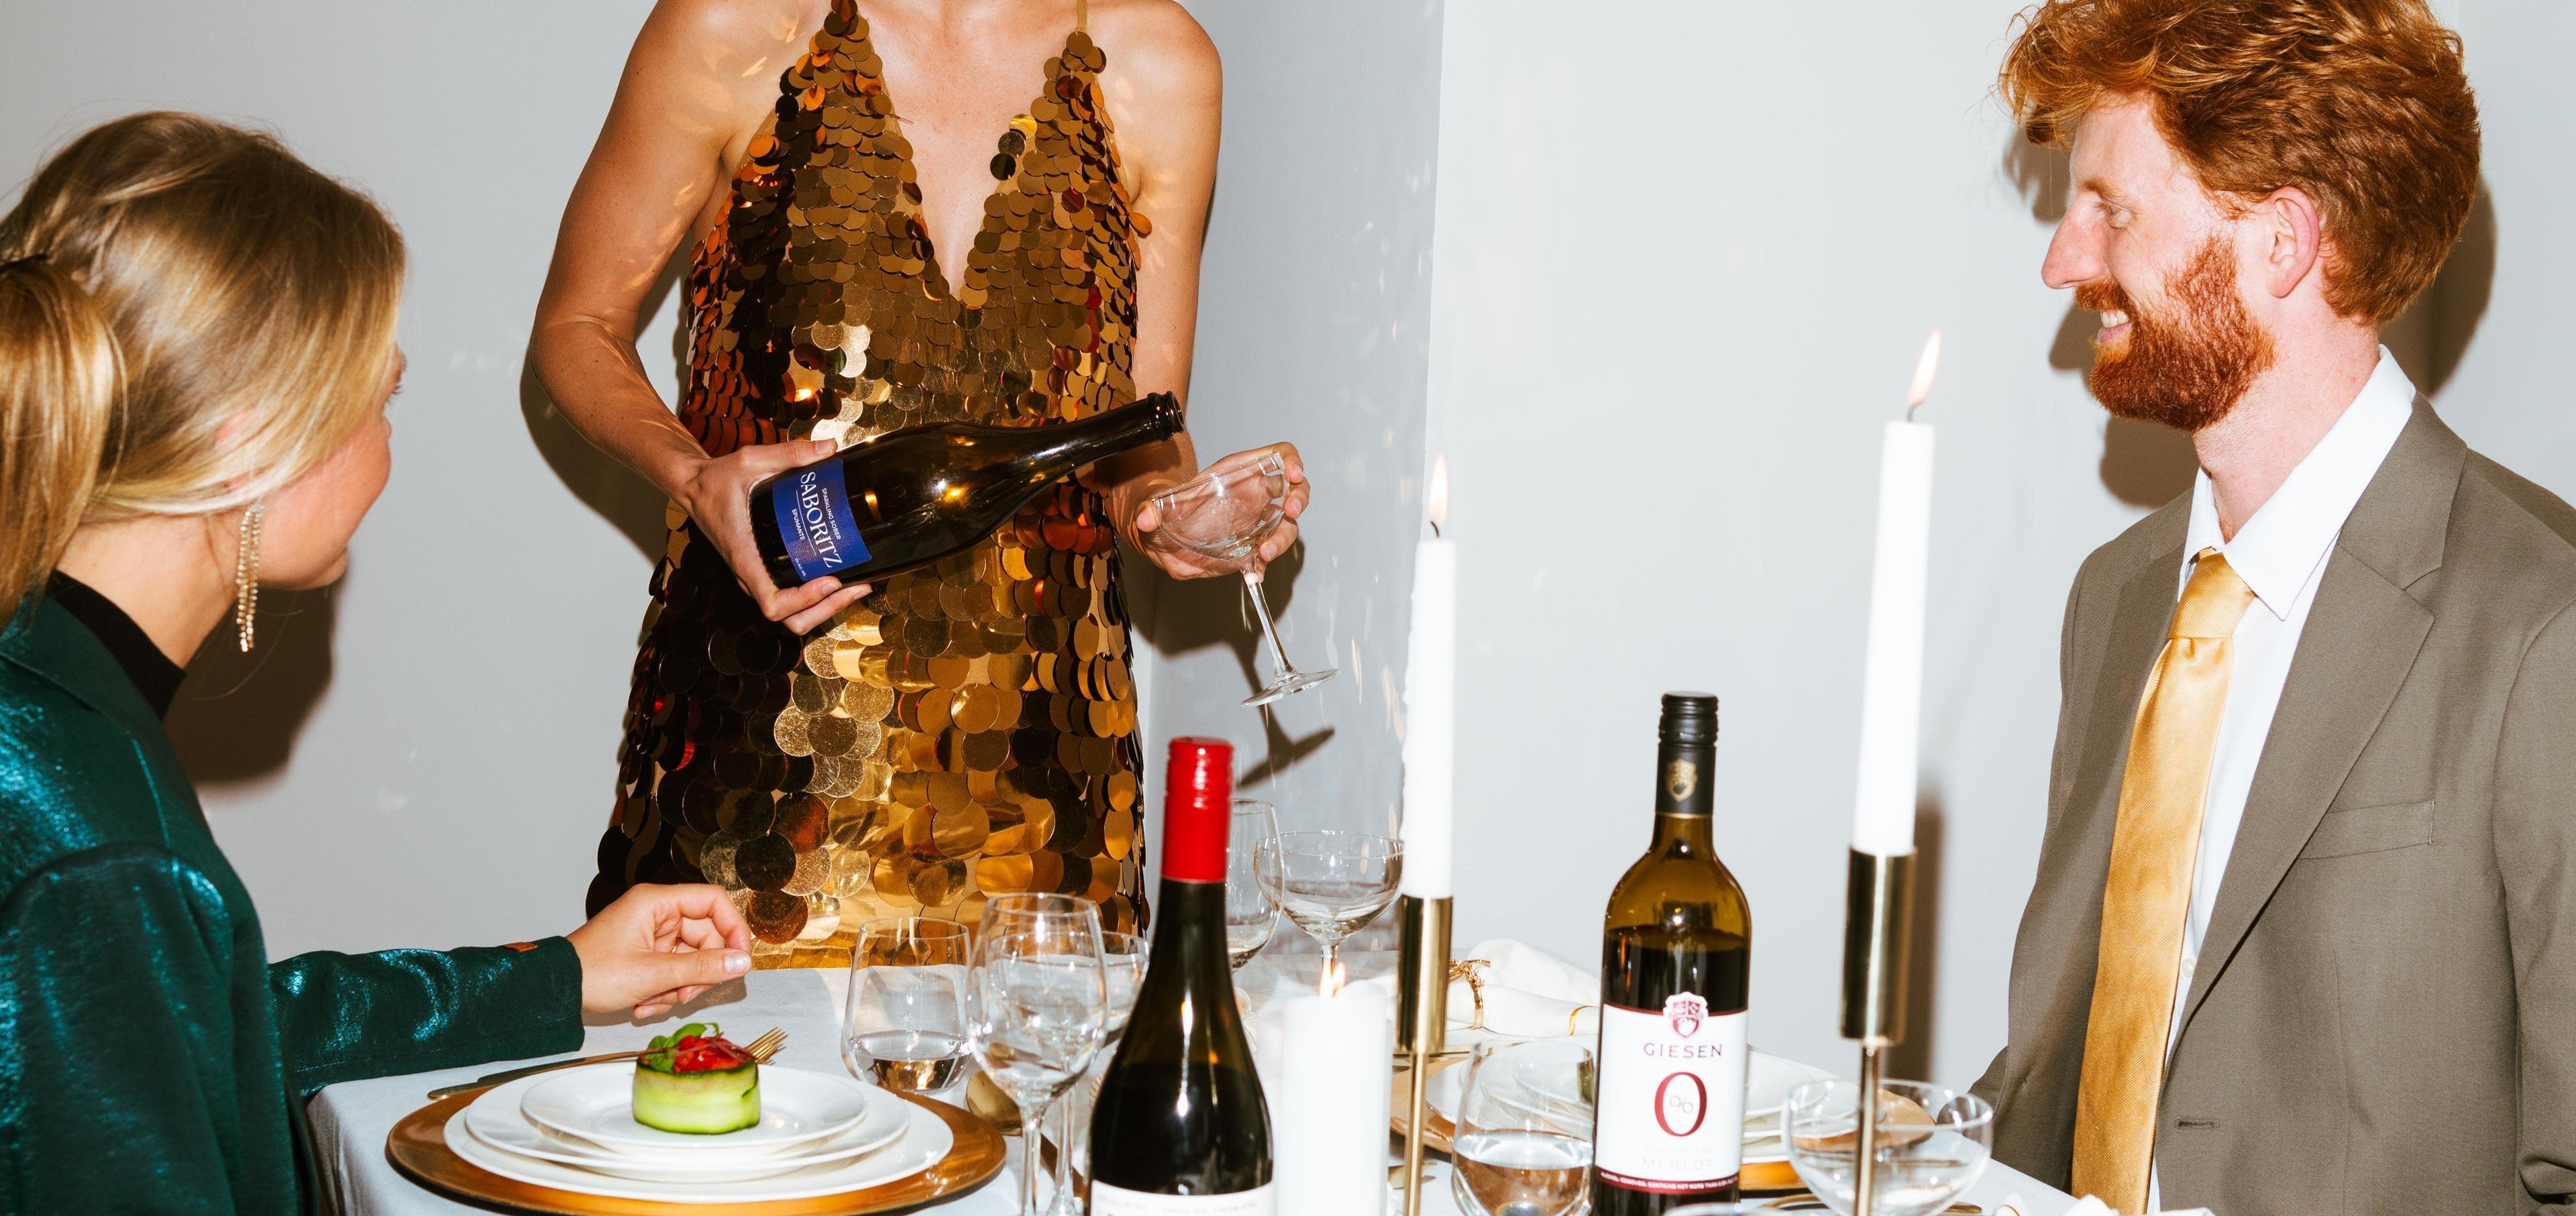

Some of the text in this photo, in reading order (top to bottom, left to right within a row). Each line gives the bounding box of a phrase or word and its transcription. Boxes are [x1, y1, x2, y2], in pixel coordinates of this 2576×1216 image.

[792, 509, 805, 541] SPUMANTE
[801, 472, 843, 568] SABORITZ
[822, 488, 841, 540] SPARKLING SOBER
[1644, 1043, 1723, 1058] GIESEN
[1643, 1157, 1715, 1170] MERLOT
